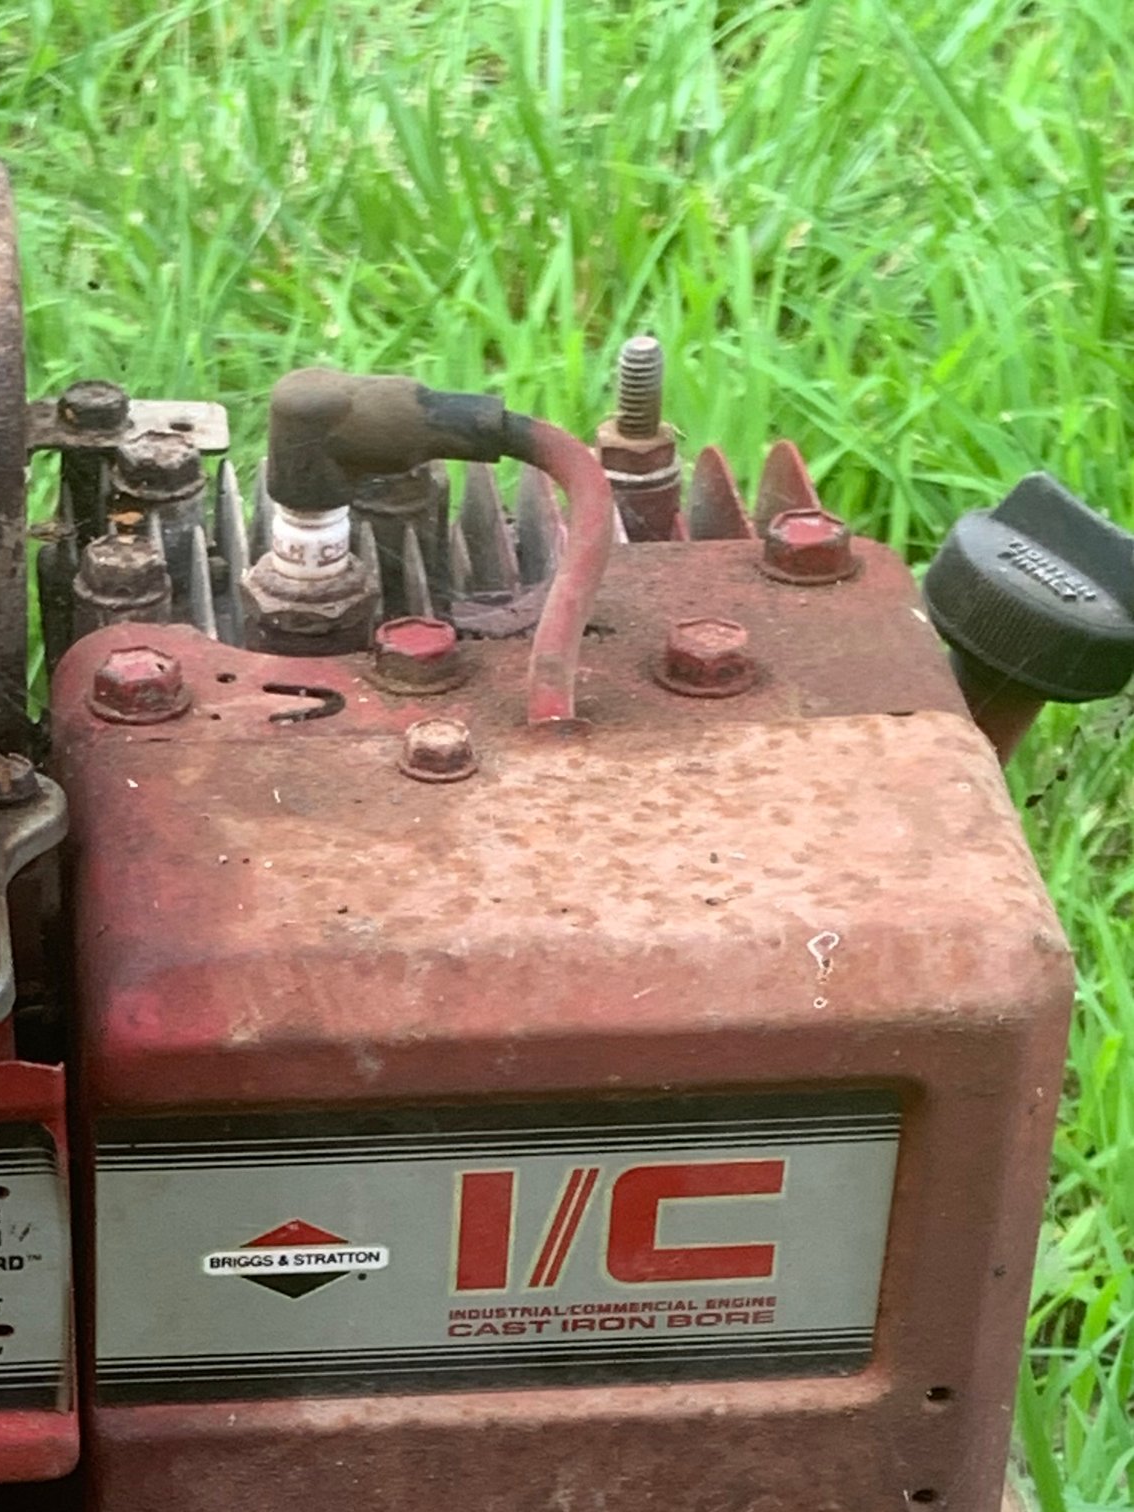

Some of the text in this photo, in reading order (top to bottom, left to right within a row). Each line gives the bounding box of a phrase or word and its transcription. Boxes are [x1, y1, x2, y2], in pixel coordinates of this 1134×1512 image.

[209, 1250, 381, 1269] BRIGGS & STRATTON
[705, 1295, 778, 1311] ENGINE
[447, 1309, 776, 1338] CAST IRON BORE
